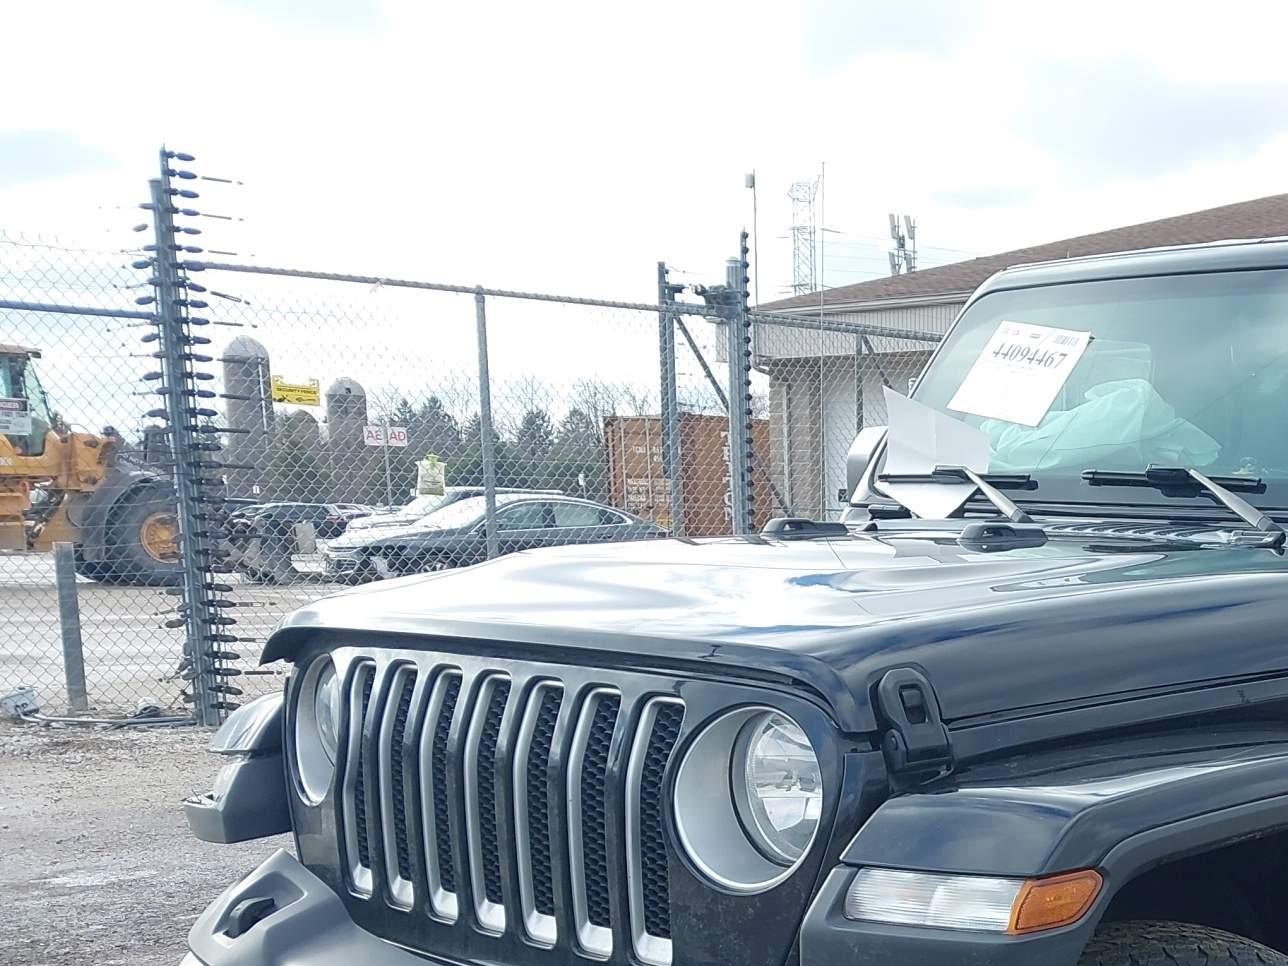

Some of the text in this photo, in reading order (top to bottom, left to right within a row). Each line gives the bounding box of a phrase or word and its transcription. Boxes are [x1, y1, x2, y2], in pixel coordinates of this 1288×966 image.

[992, 344, 1068, 369] 44094467
[366, 429, 383, 442] AE
[389, 430, 406, 442] AD
